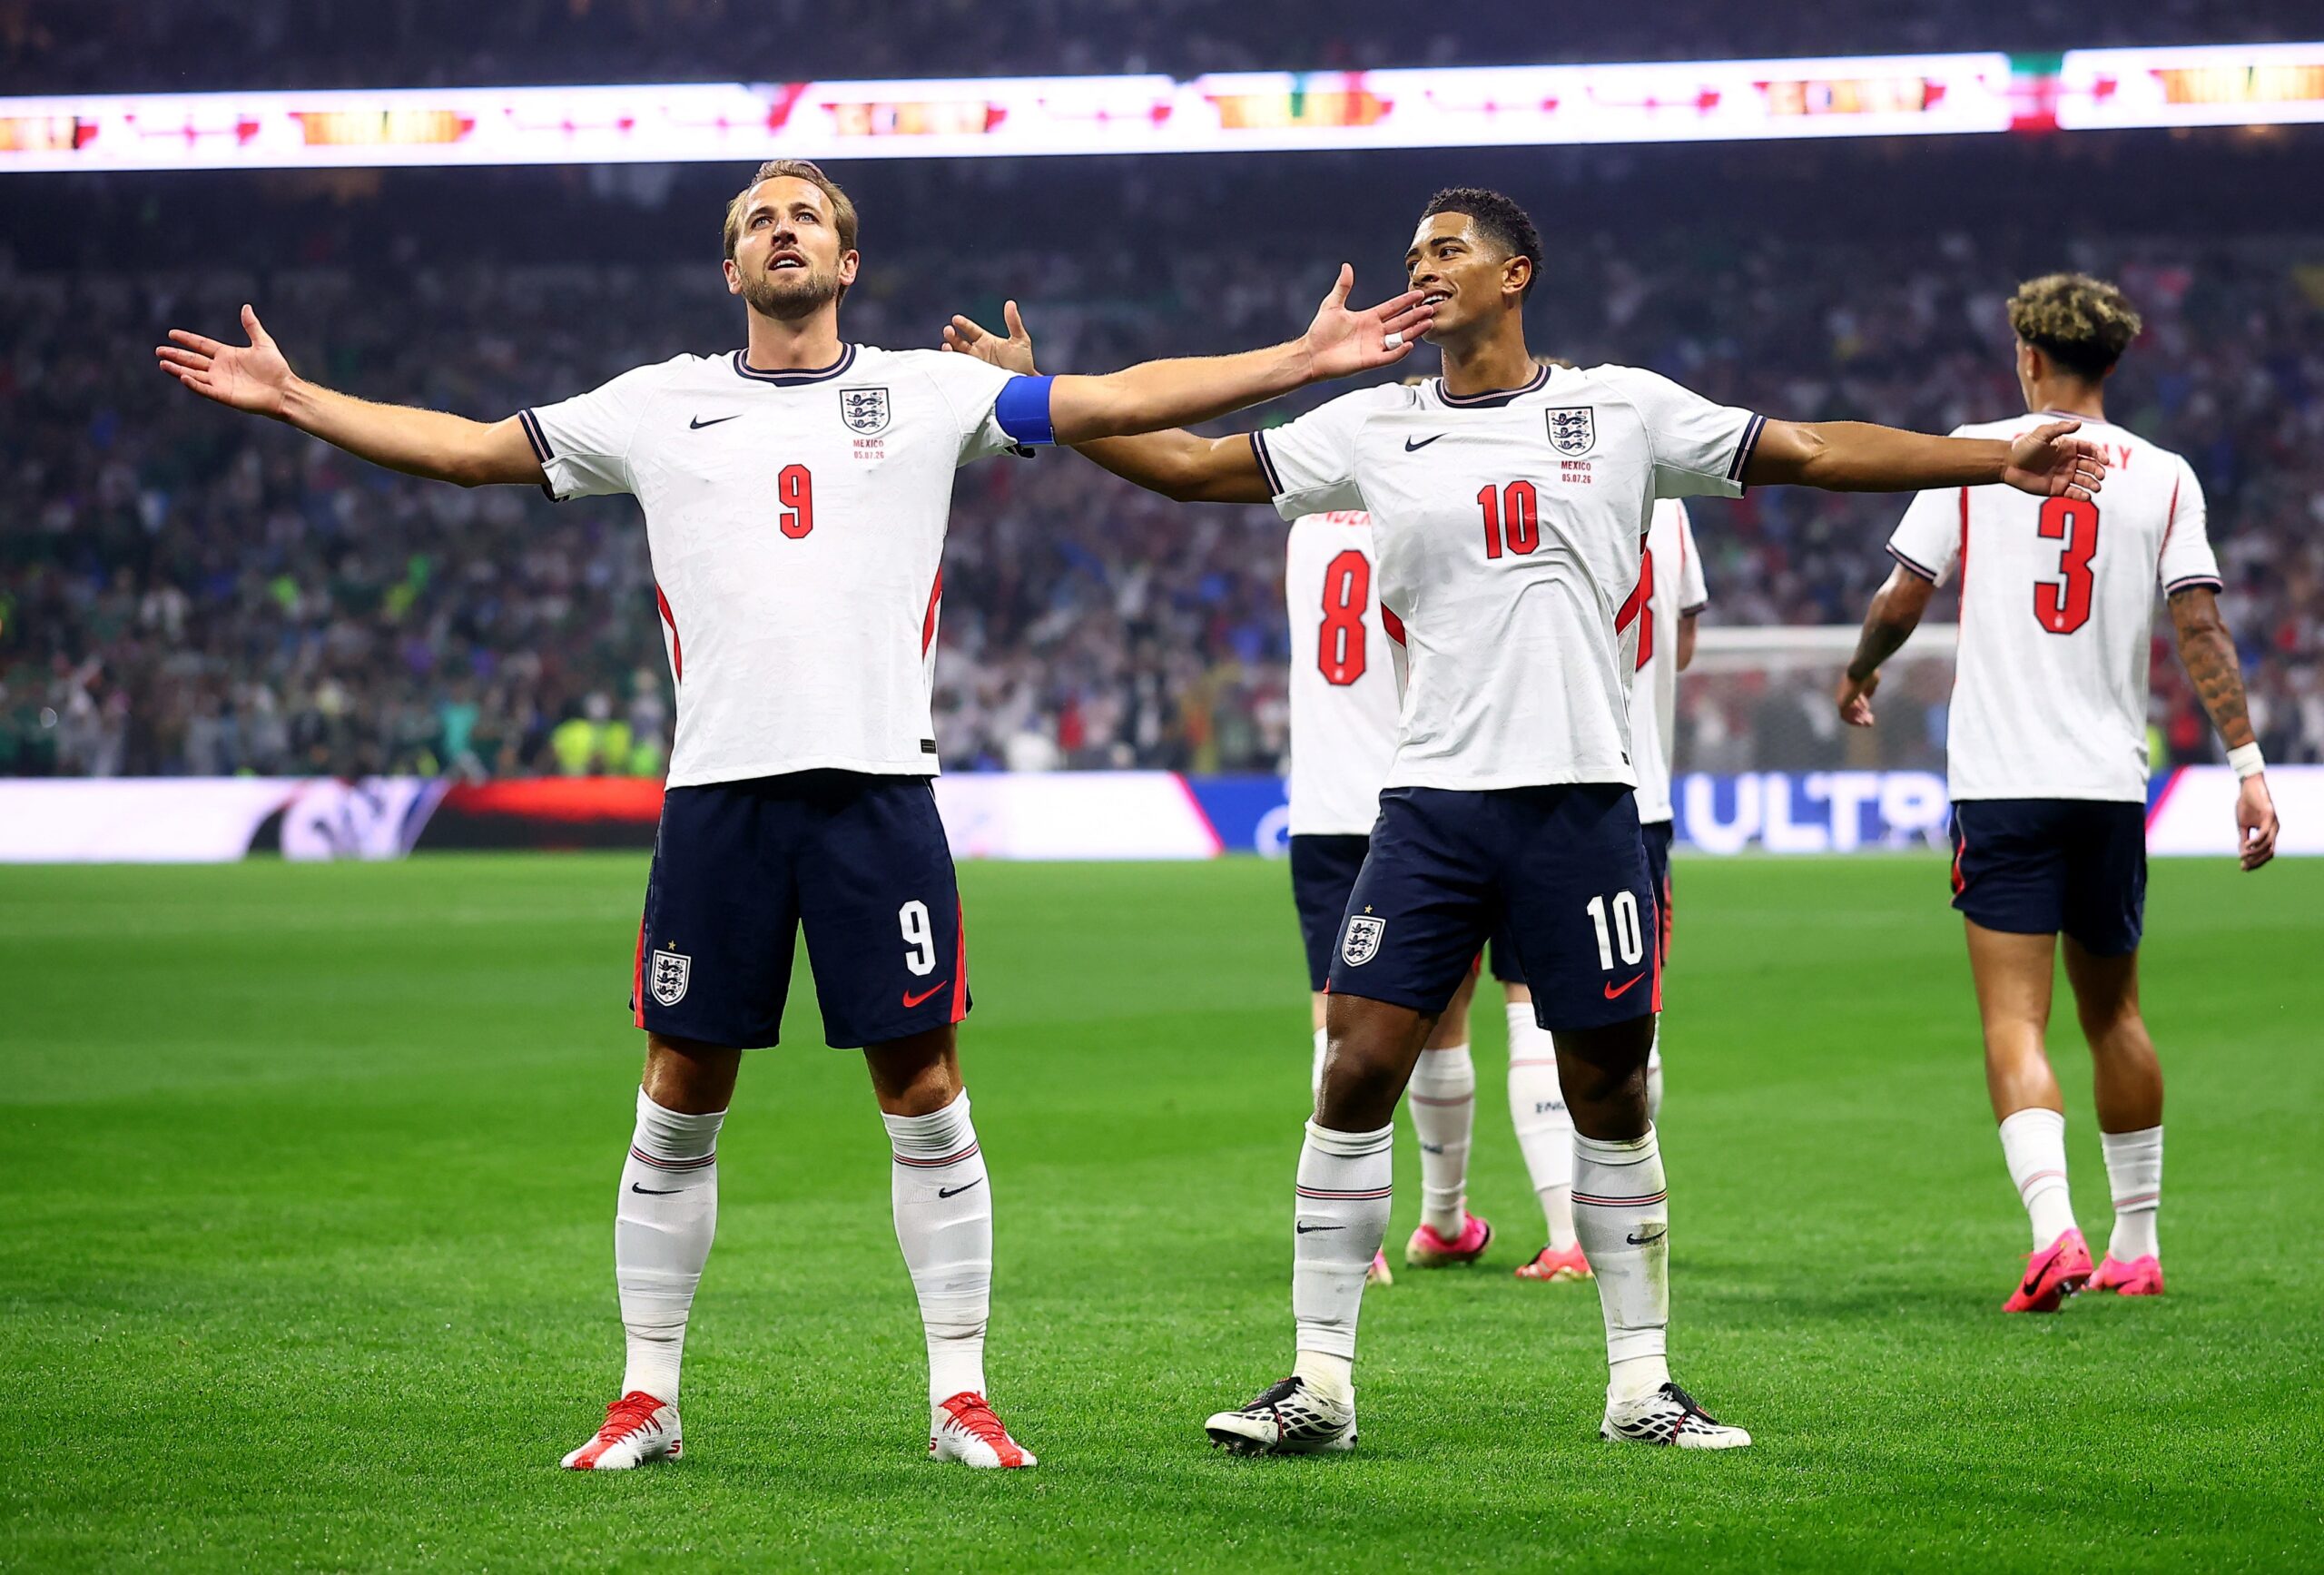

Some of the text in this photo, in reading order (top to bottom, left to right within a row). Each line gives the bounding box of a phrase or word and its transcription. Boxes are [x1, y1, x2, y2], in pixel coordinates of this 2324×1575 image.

[852, 438, 884, 448] MEXICO
[1561, 460, 1591, 471] MEXICO
[1561, 473, 1591, 484] 05.07.26
[778, 464, 812, 539] 9
[1477, 480, 1540, 559] 10
[2034, 496, 2100, 634] 3
[1318, 549, 1370, 686] 8
[898, 899, 936, 976] 9
[1586, 890, 1643, 970] 10
